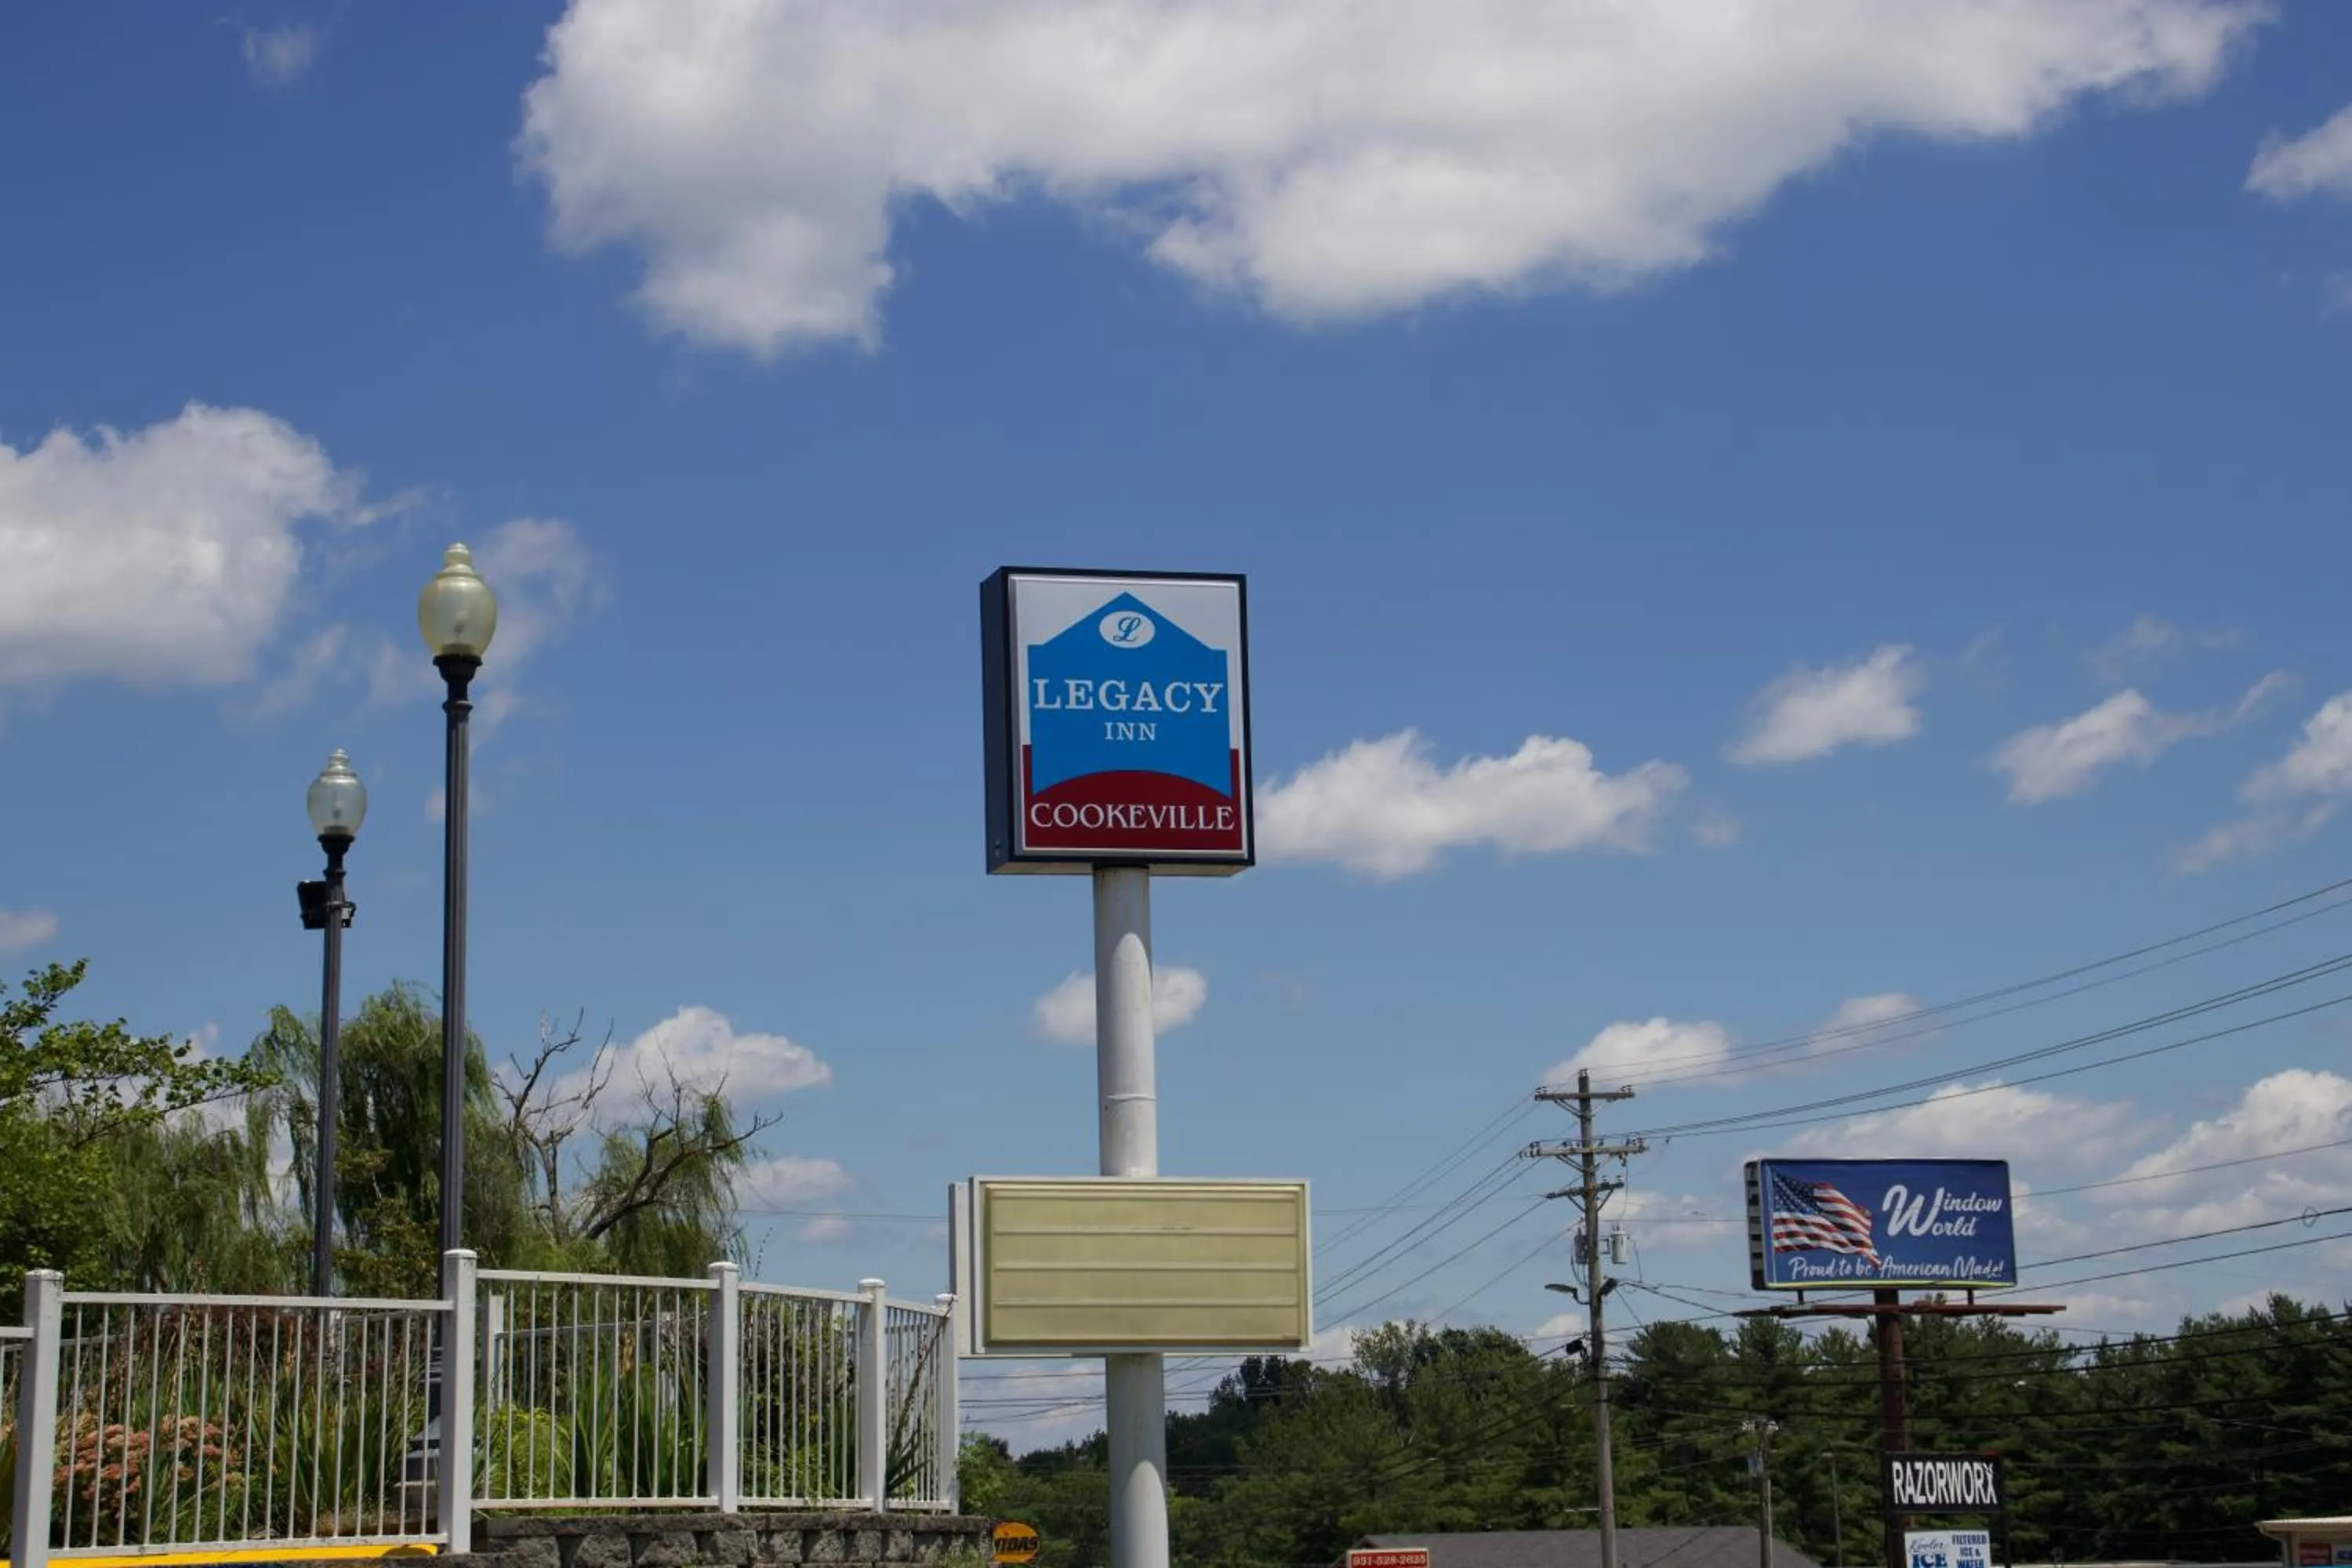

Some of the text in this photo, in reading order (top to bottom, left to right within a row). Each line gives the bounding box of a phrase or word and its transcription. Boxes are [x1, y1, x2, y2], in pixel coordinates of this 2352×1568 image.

[1112, 616, 1141, 642] L
[1033, 677, 1225, 713] LEGACY
[1103, 721, 1158, 741] INN
[1029, 802, 1236, 830] COOKEVILLE
[1882, 1184, 2002, 1237] Window
[1788, 1254, 2005, 1280] Proud to be American Made!
[1951, 1534, 1987, 1545] FILTERED
[1911, 1553, 1948, 1568] ICE
